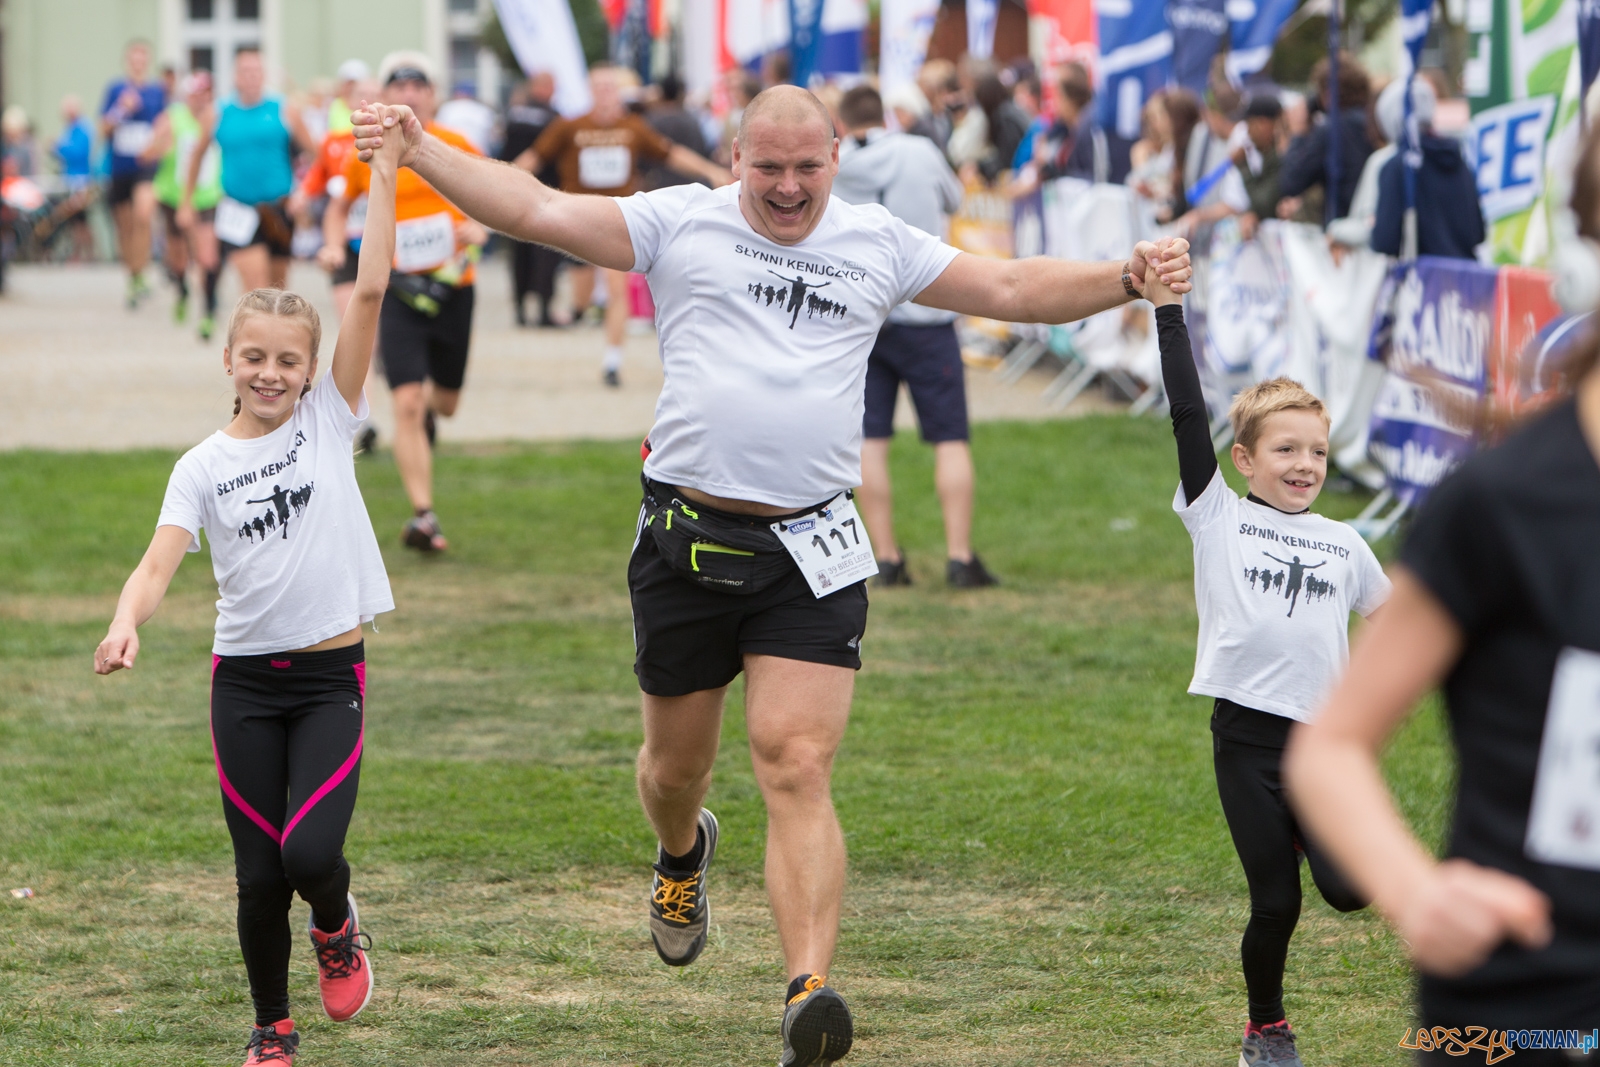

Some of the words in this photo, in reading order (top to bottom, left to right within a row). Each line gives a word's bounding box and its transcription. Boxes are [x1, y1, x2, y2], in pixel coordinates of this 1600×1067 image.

[734, 244, 783, 266] SŁYNNI
[786, 258, 867, 283] KENIJCZYCY
[216, 470, 258, 497] SŁYNNI
[260, 430, 307, 479] KENJCCY
[811, 517, 860, 558] 117
[1239, 523, 1279, 542] SŁYNNI
[1281, 535, 1350, 560] KENIJCZYCY
[827, 565, 838, 575] 39
[837, 559, 854, 571] BIEG
